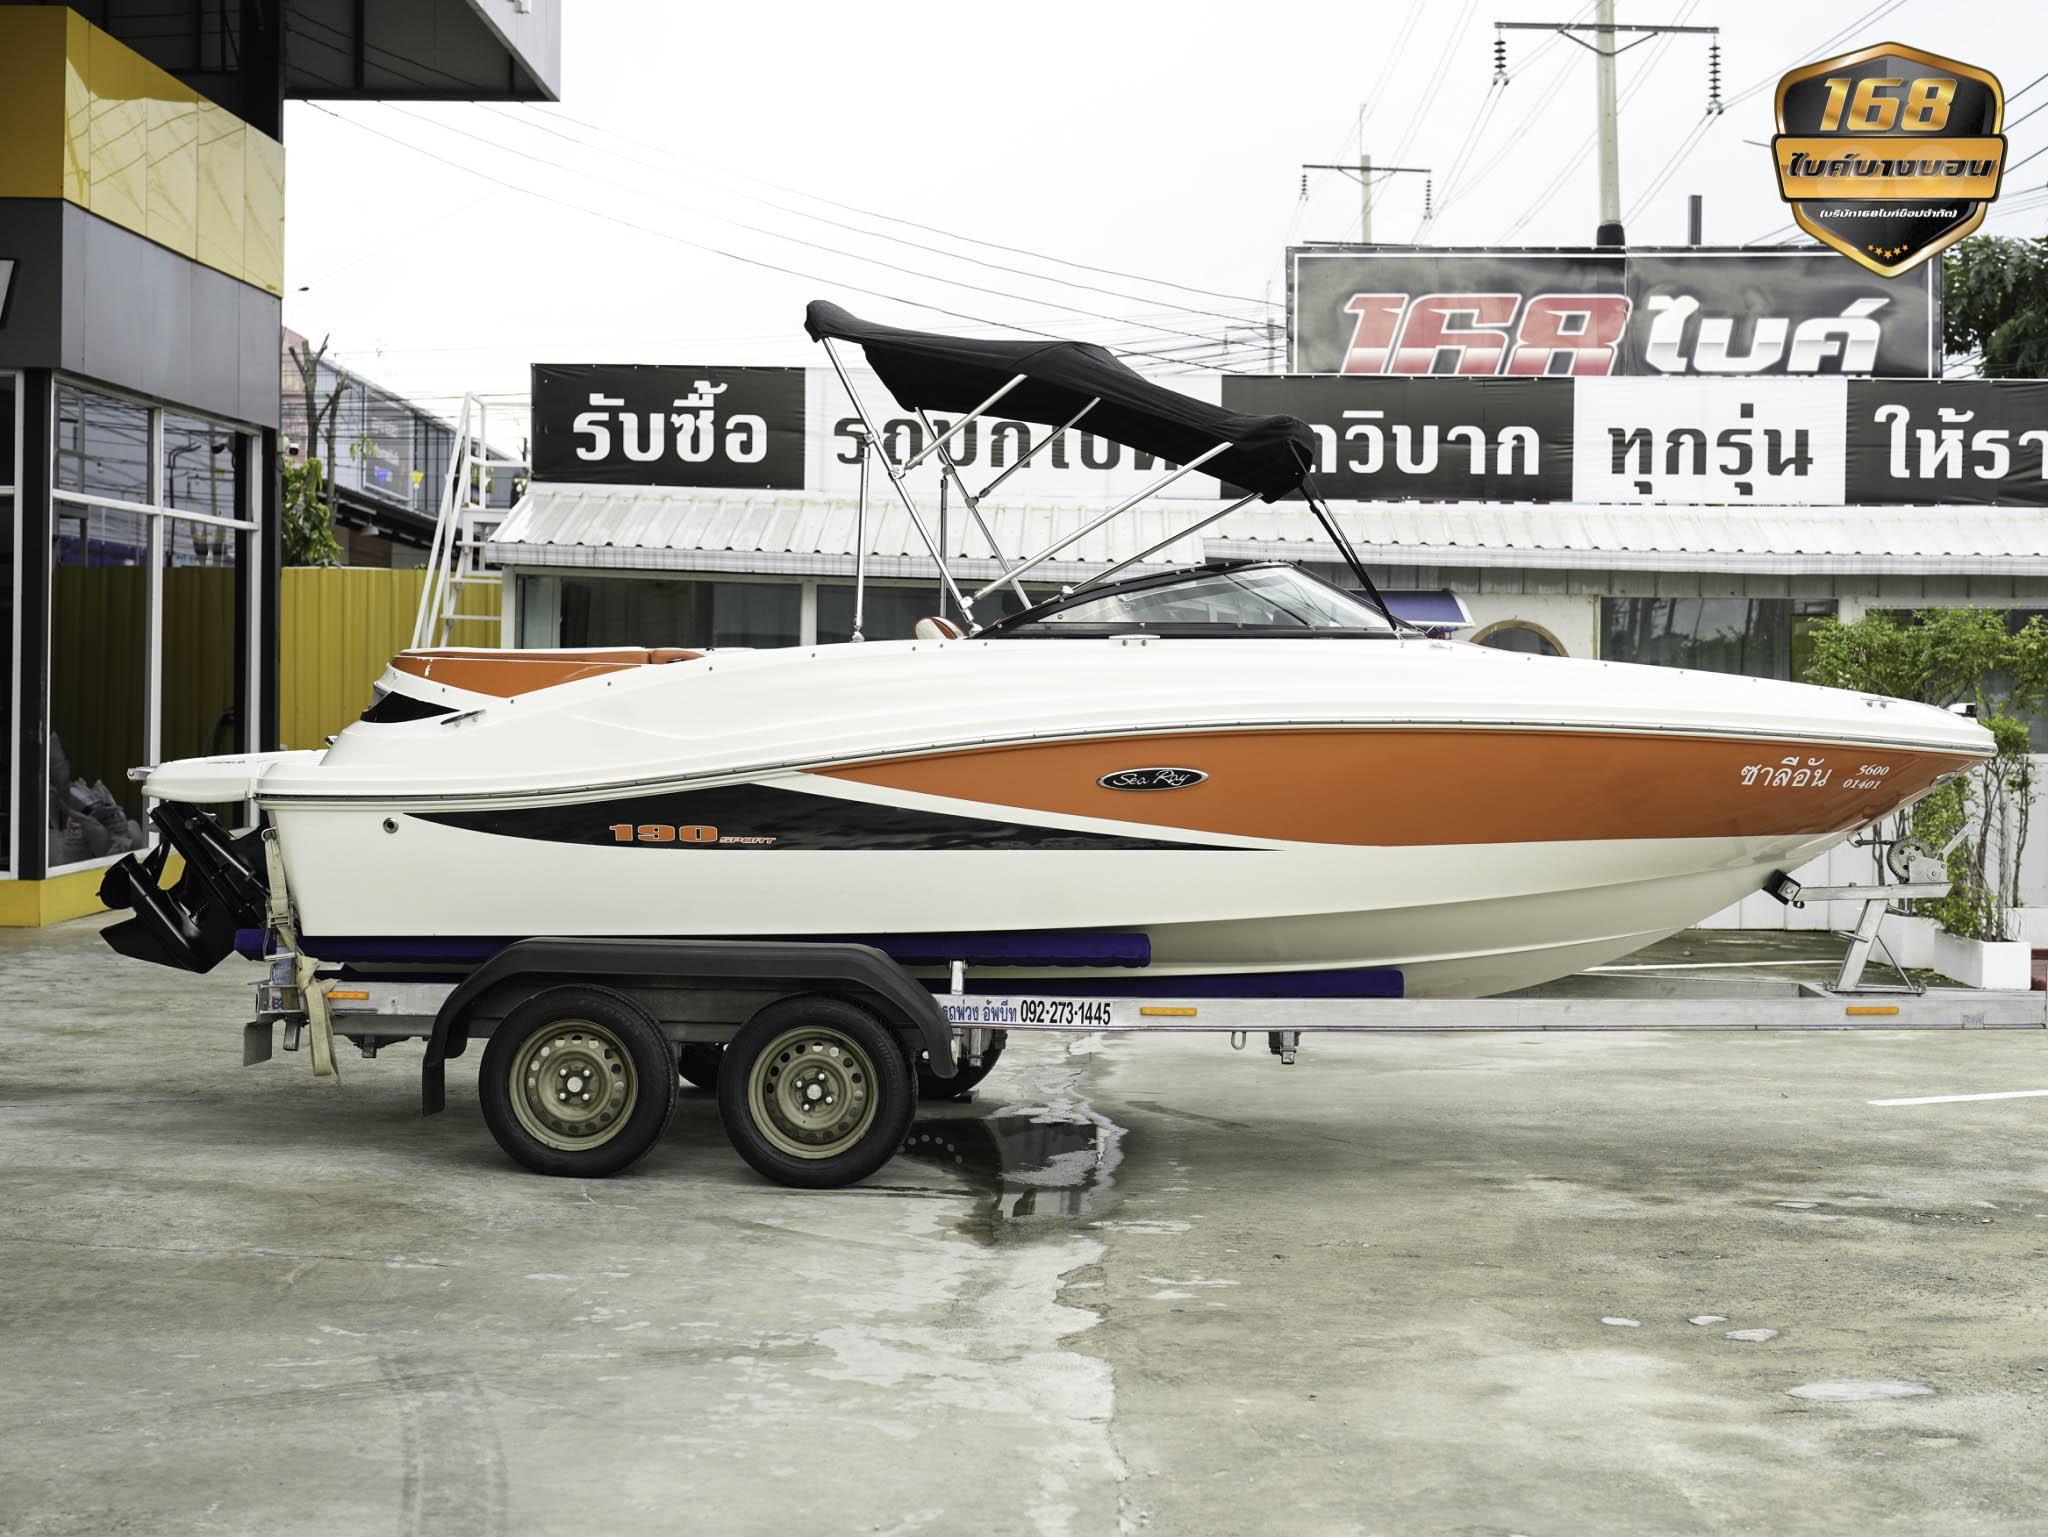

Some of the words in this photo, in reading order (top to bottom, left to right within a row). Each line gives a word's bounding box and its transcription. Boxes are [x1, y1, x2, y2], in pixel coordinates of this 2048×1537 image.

[1341, 293, 1632, 375] 168
[1645, 295, 1890, 372] ไบค์
[573, 380, 767, 463] รับซื้อ
[1607, 403, 1813, 496] ทุกรุ่น
[1113, 773, 1148, 786] Sea
[1152, 769, 1191, 786] Ray
[1856, 764, 1890, 776] 5600
[1843, 778, 1881, 790] 01401
[609, 824, 718, 843] 190
